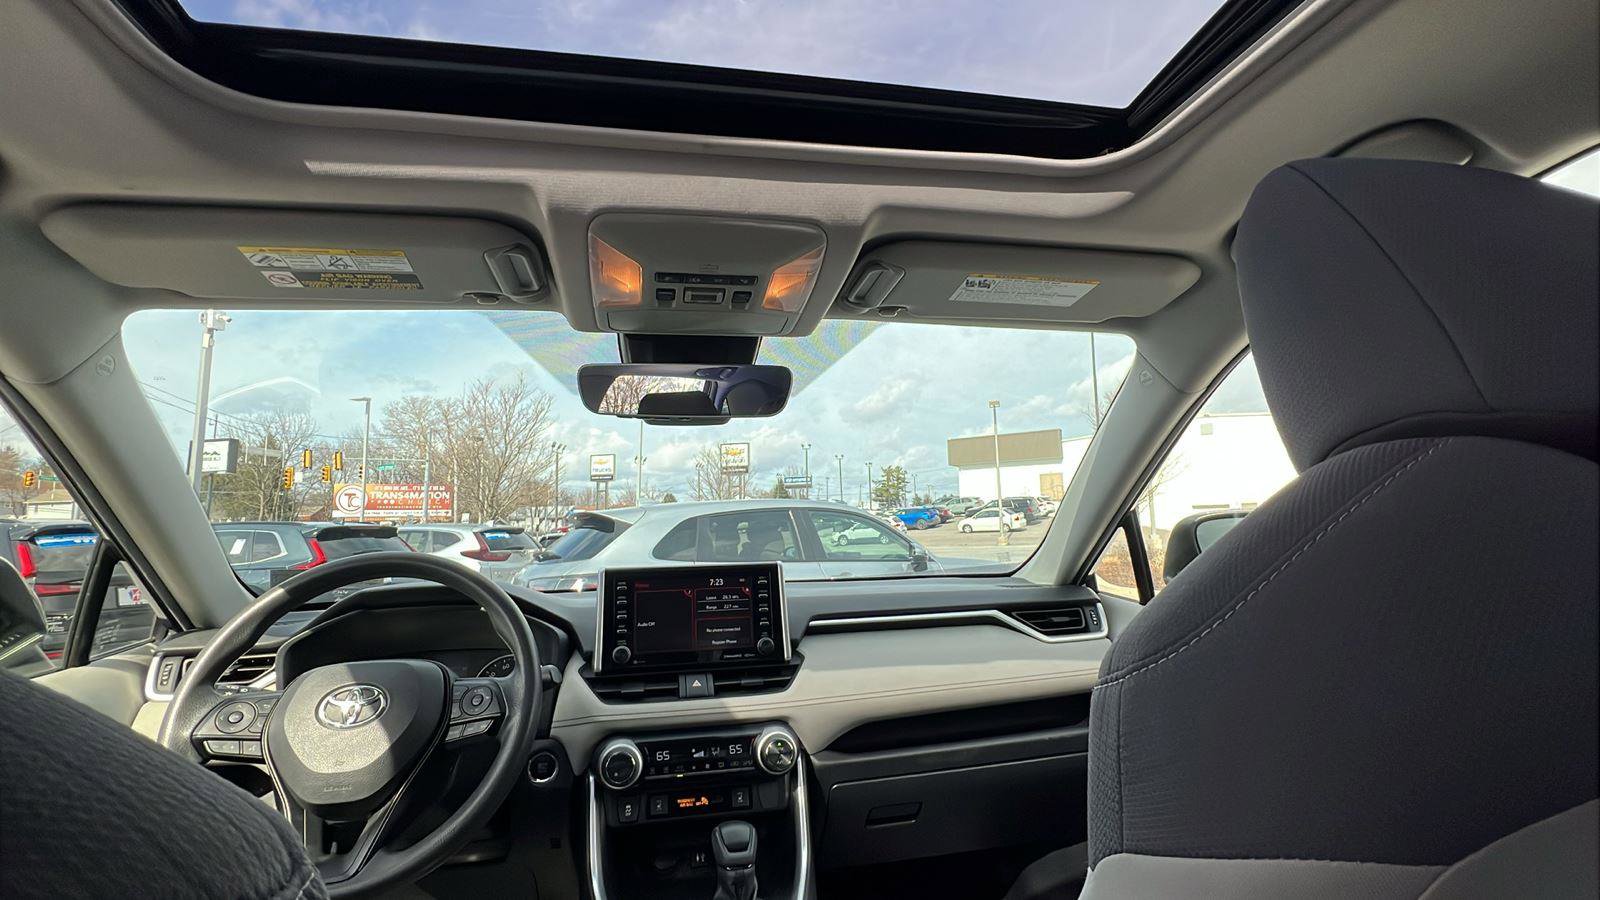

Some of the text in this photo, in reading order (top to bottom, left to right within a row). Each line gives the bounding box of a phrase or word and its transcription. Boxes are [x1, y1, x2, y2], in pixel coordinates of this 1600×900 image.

[370, 491, 450, 499] TRANS4MAION
[709, 578, 724, 586] 7:23
[729, 744, 743, 755] 65
[656, 750, 670, 761] 65
